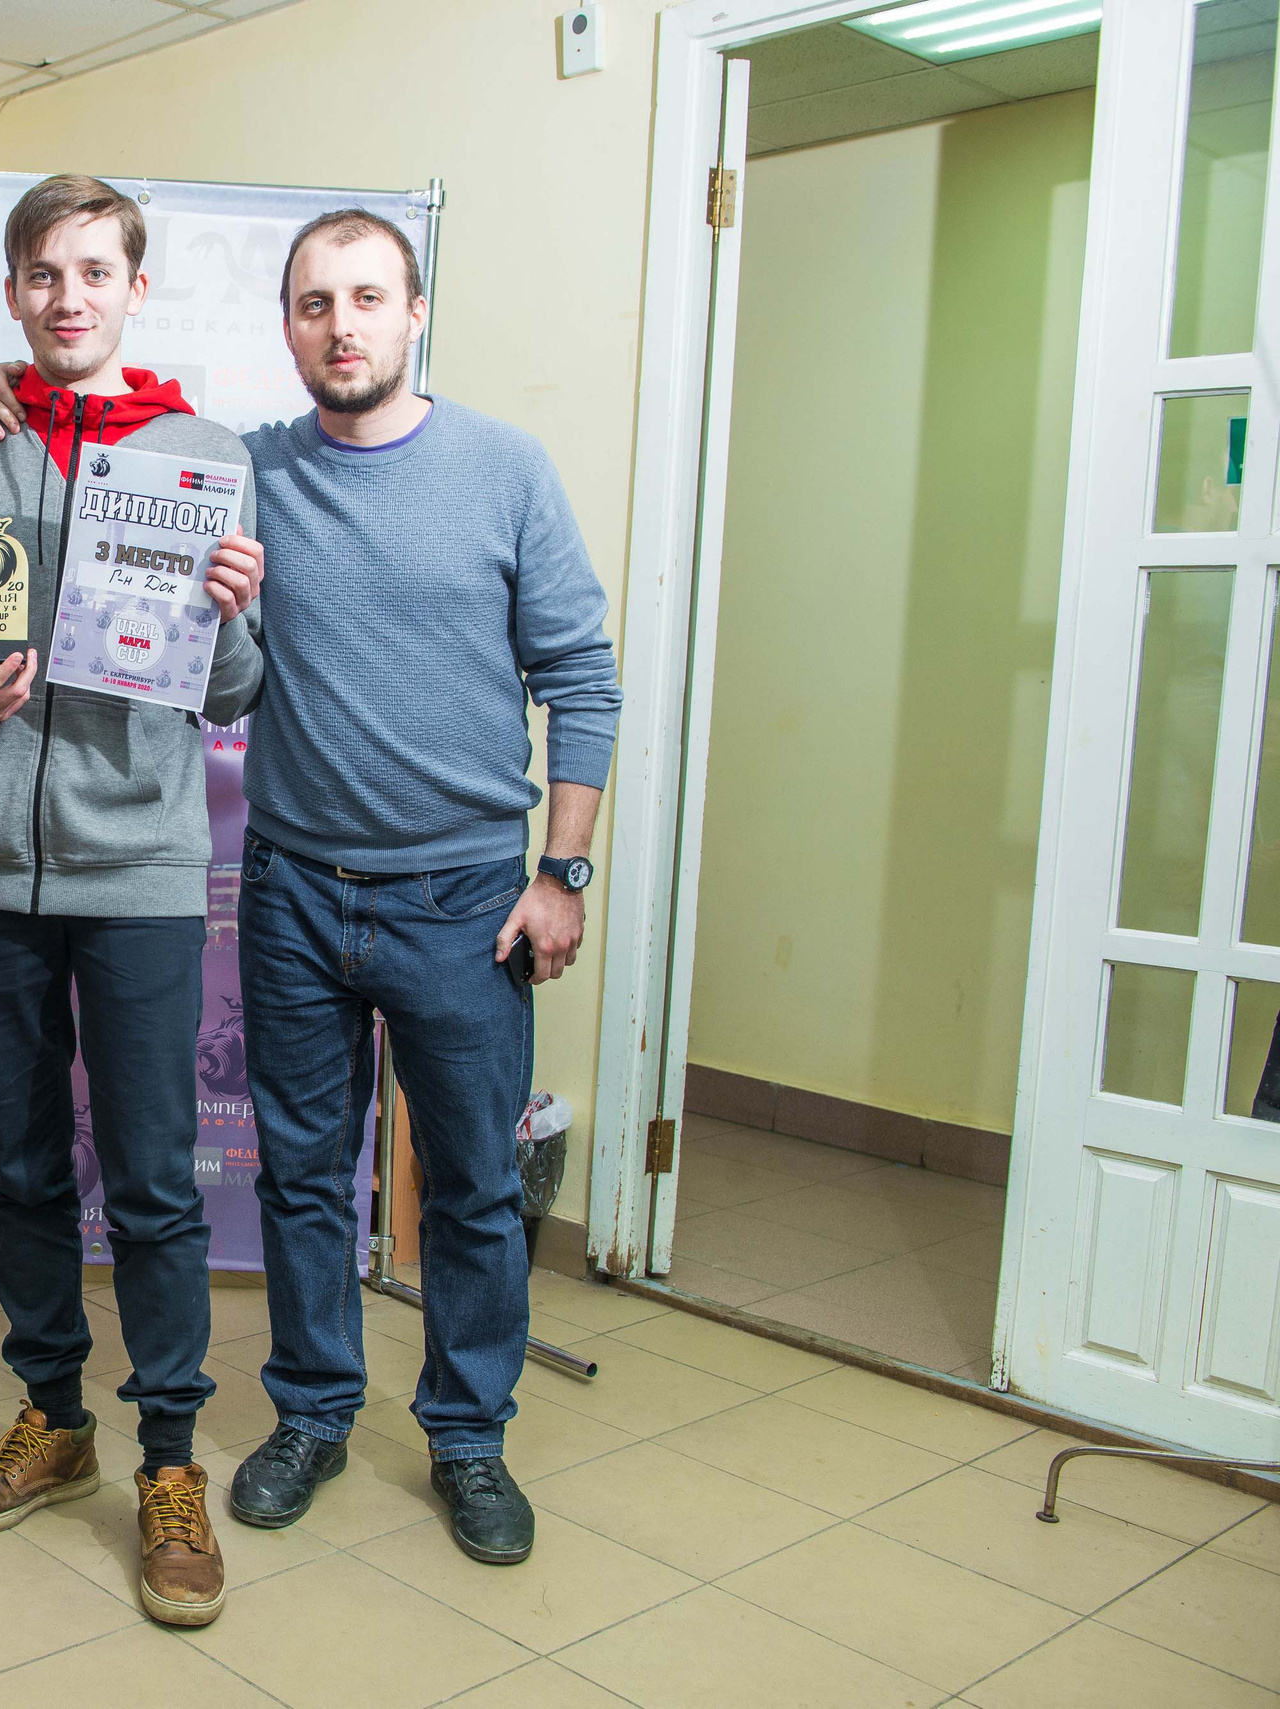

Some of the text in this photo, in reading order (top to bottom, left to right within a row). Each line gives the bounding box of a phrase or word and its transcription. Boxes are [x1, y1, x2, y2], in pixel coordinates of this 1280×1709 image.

[131, 316, 265, 336] HOOKAH
[203, 484, 236, 497] МАФИЯ
[79, 487, 228, 537] ДИПЛОМ
[95, 541, 194, 576] 3 МЕСТО
[7, 581, 24, 591] 20
[116, 618, 159, 640] URAL
[118, 634, 151, 650] MAFIA
[116, 645, 150, 665] CUP
[110, 671, 156, 685] ЕКАТЕРИНБУРГ
